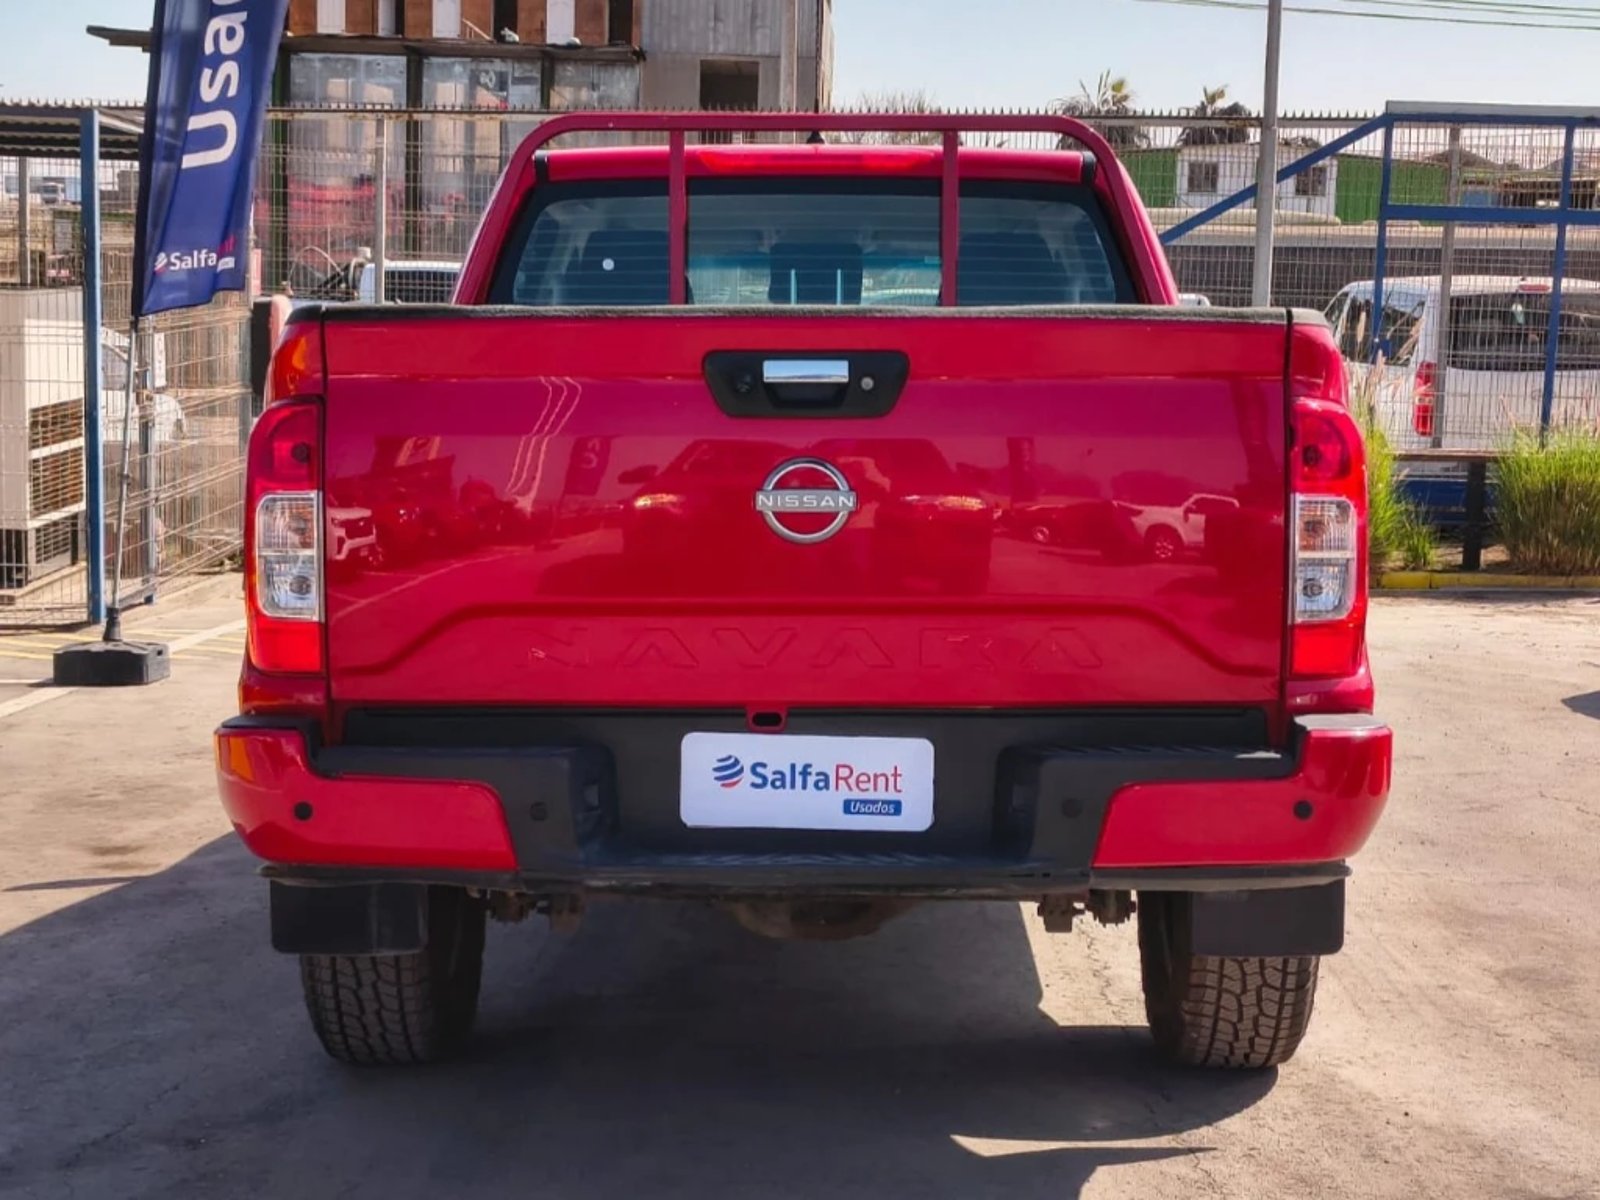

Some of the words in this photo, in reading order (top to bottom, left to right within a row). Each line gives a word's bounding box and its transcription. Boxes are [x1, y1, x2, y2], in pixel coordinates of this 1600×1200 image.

[758, 493, 855, 508] NISSAN
[511, 626, 1104, 669] NAVARA
[849, 800, 896, 814] Usados
